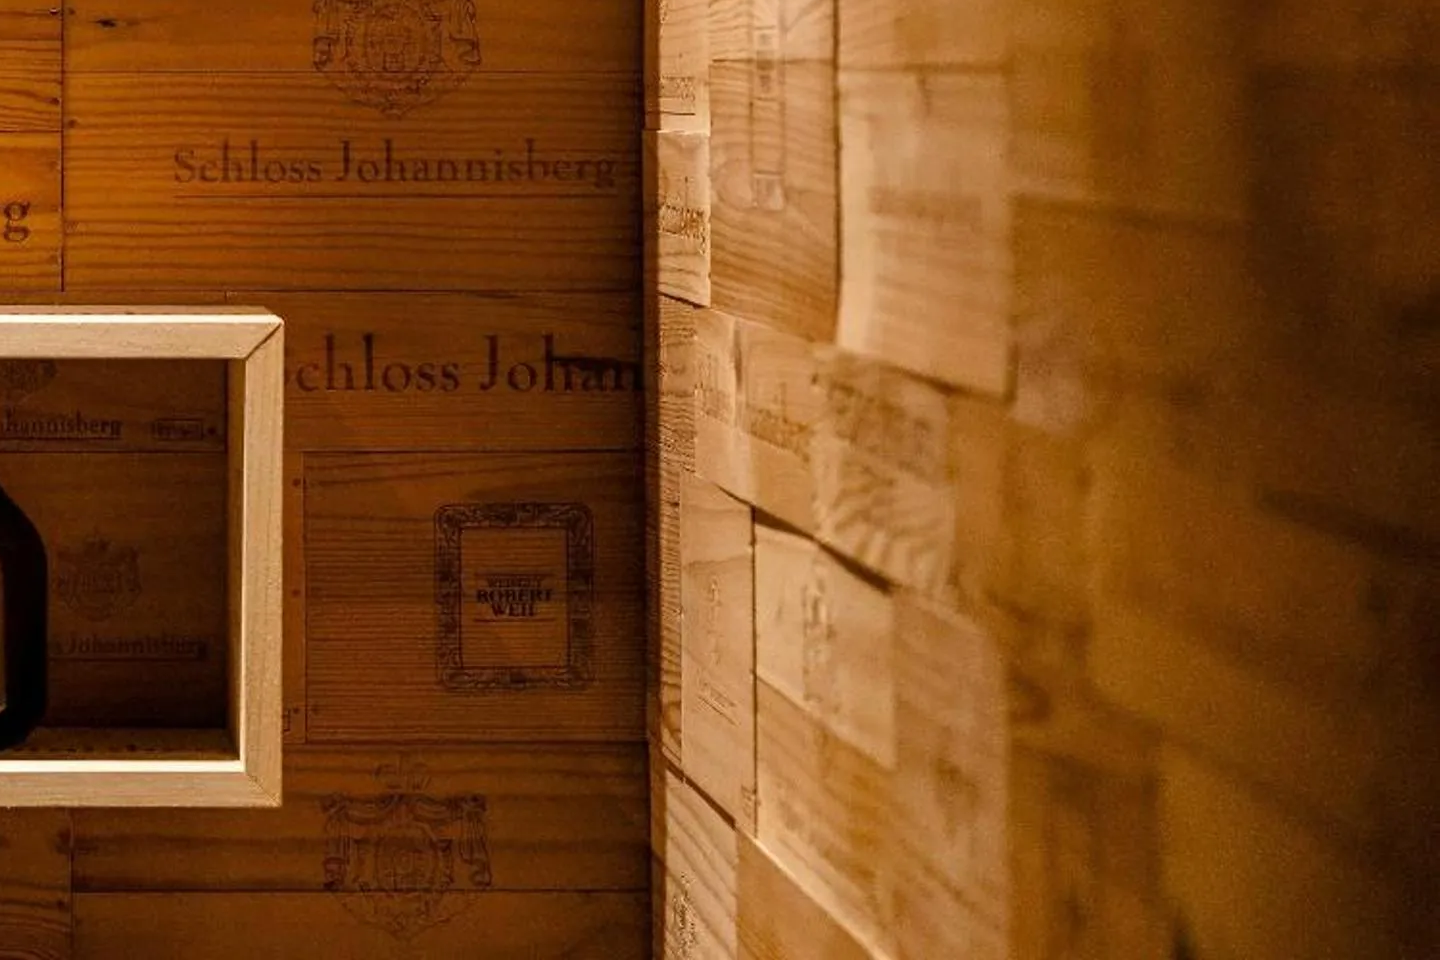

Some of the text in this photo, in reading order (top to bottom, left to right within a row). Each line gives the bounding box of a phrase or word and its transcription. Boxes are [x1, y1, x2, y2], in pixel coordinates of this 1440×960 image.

[173, 137, 616, 190] Schloss Johannisberg
[287, 332, 461, 393] chloss
